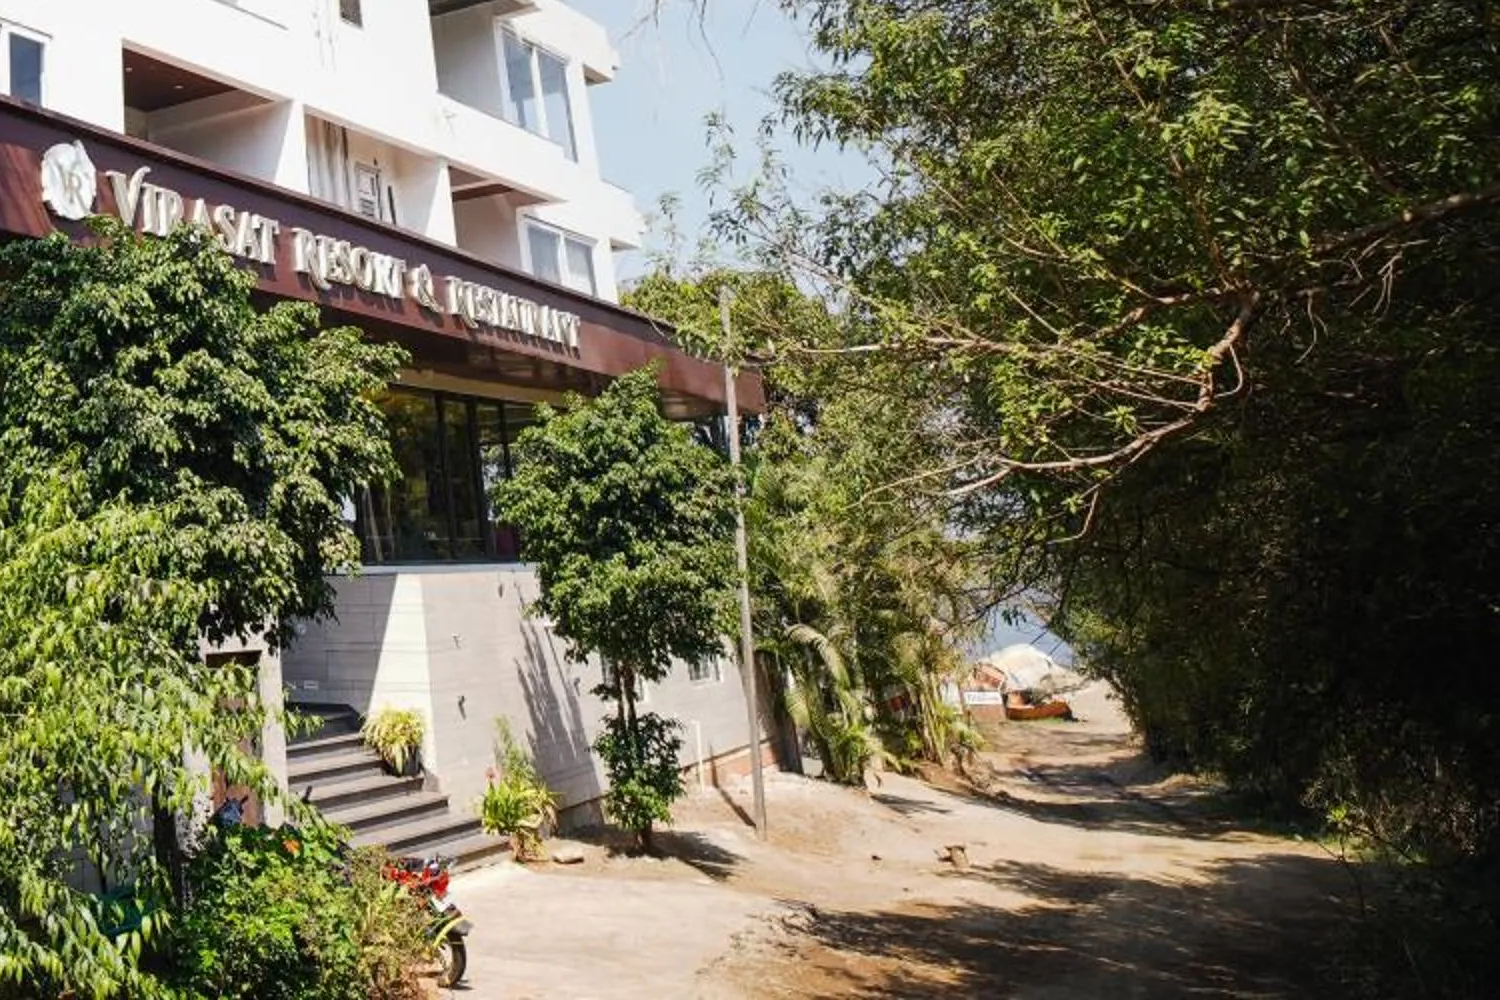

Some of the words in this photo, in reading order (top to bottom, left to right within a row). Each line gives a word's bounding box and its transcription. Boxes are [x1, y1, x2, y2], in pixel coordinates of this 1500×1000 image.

[105, 166, 280, 265] VIRASAT
[292, 227, 406, 299] RESORT
[406, 264, 445, 312] &
[444, 275, 581, 347] RESTAURANT
